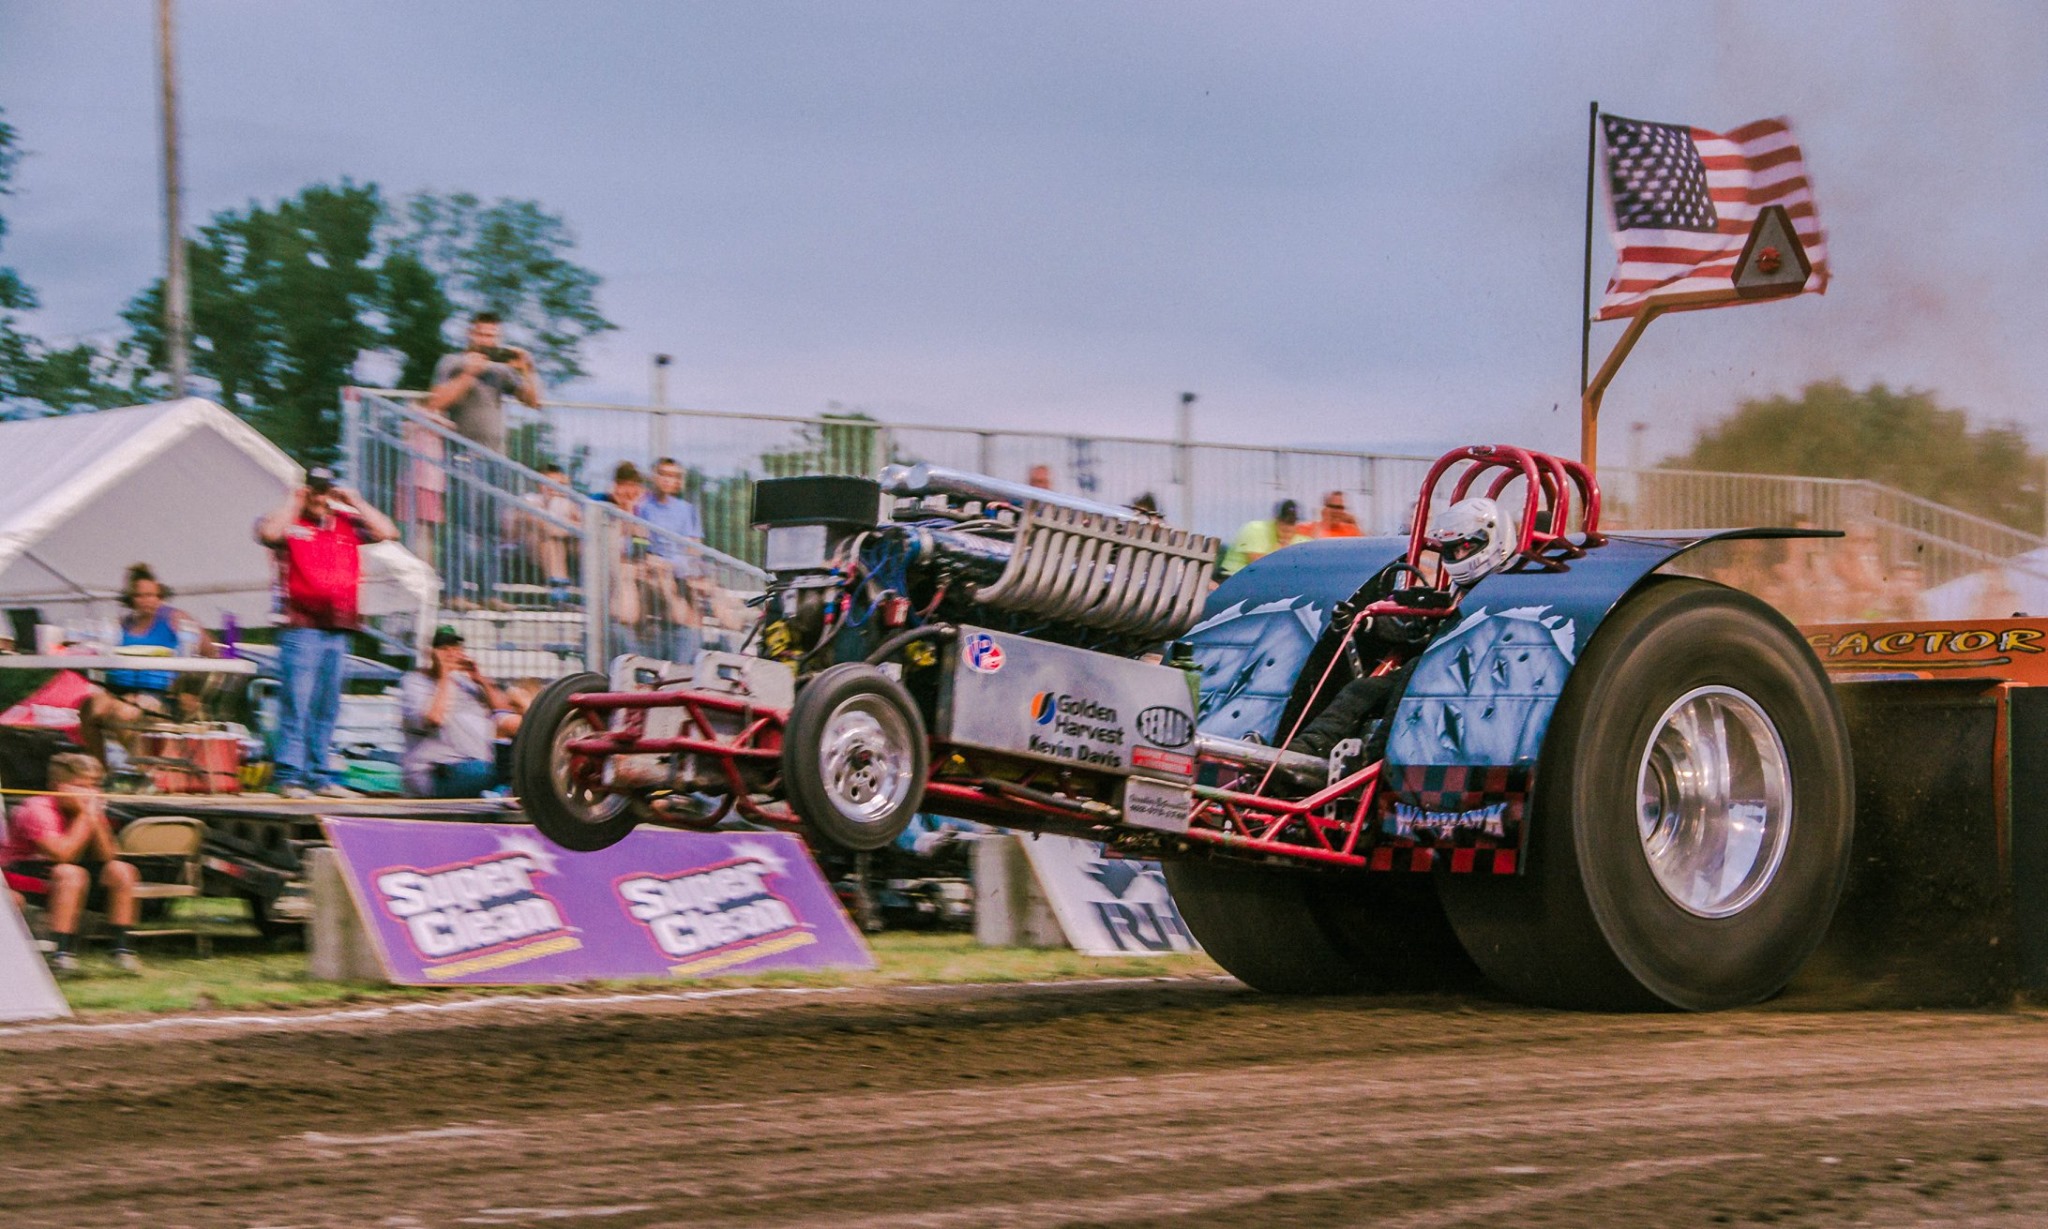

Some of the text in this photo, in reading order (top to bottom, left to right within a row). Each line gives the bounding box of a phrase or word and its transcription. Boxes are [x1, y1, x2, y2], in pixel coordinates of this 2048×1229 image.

[1058, 694, 1117, 723] Golden
[1055, 715, 1124, 745] Harvest
[1028, 734, 1073, 758] Kevin
[1078, 744, 1121, 767] Davis
